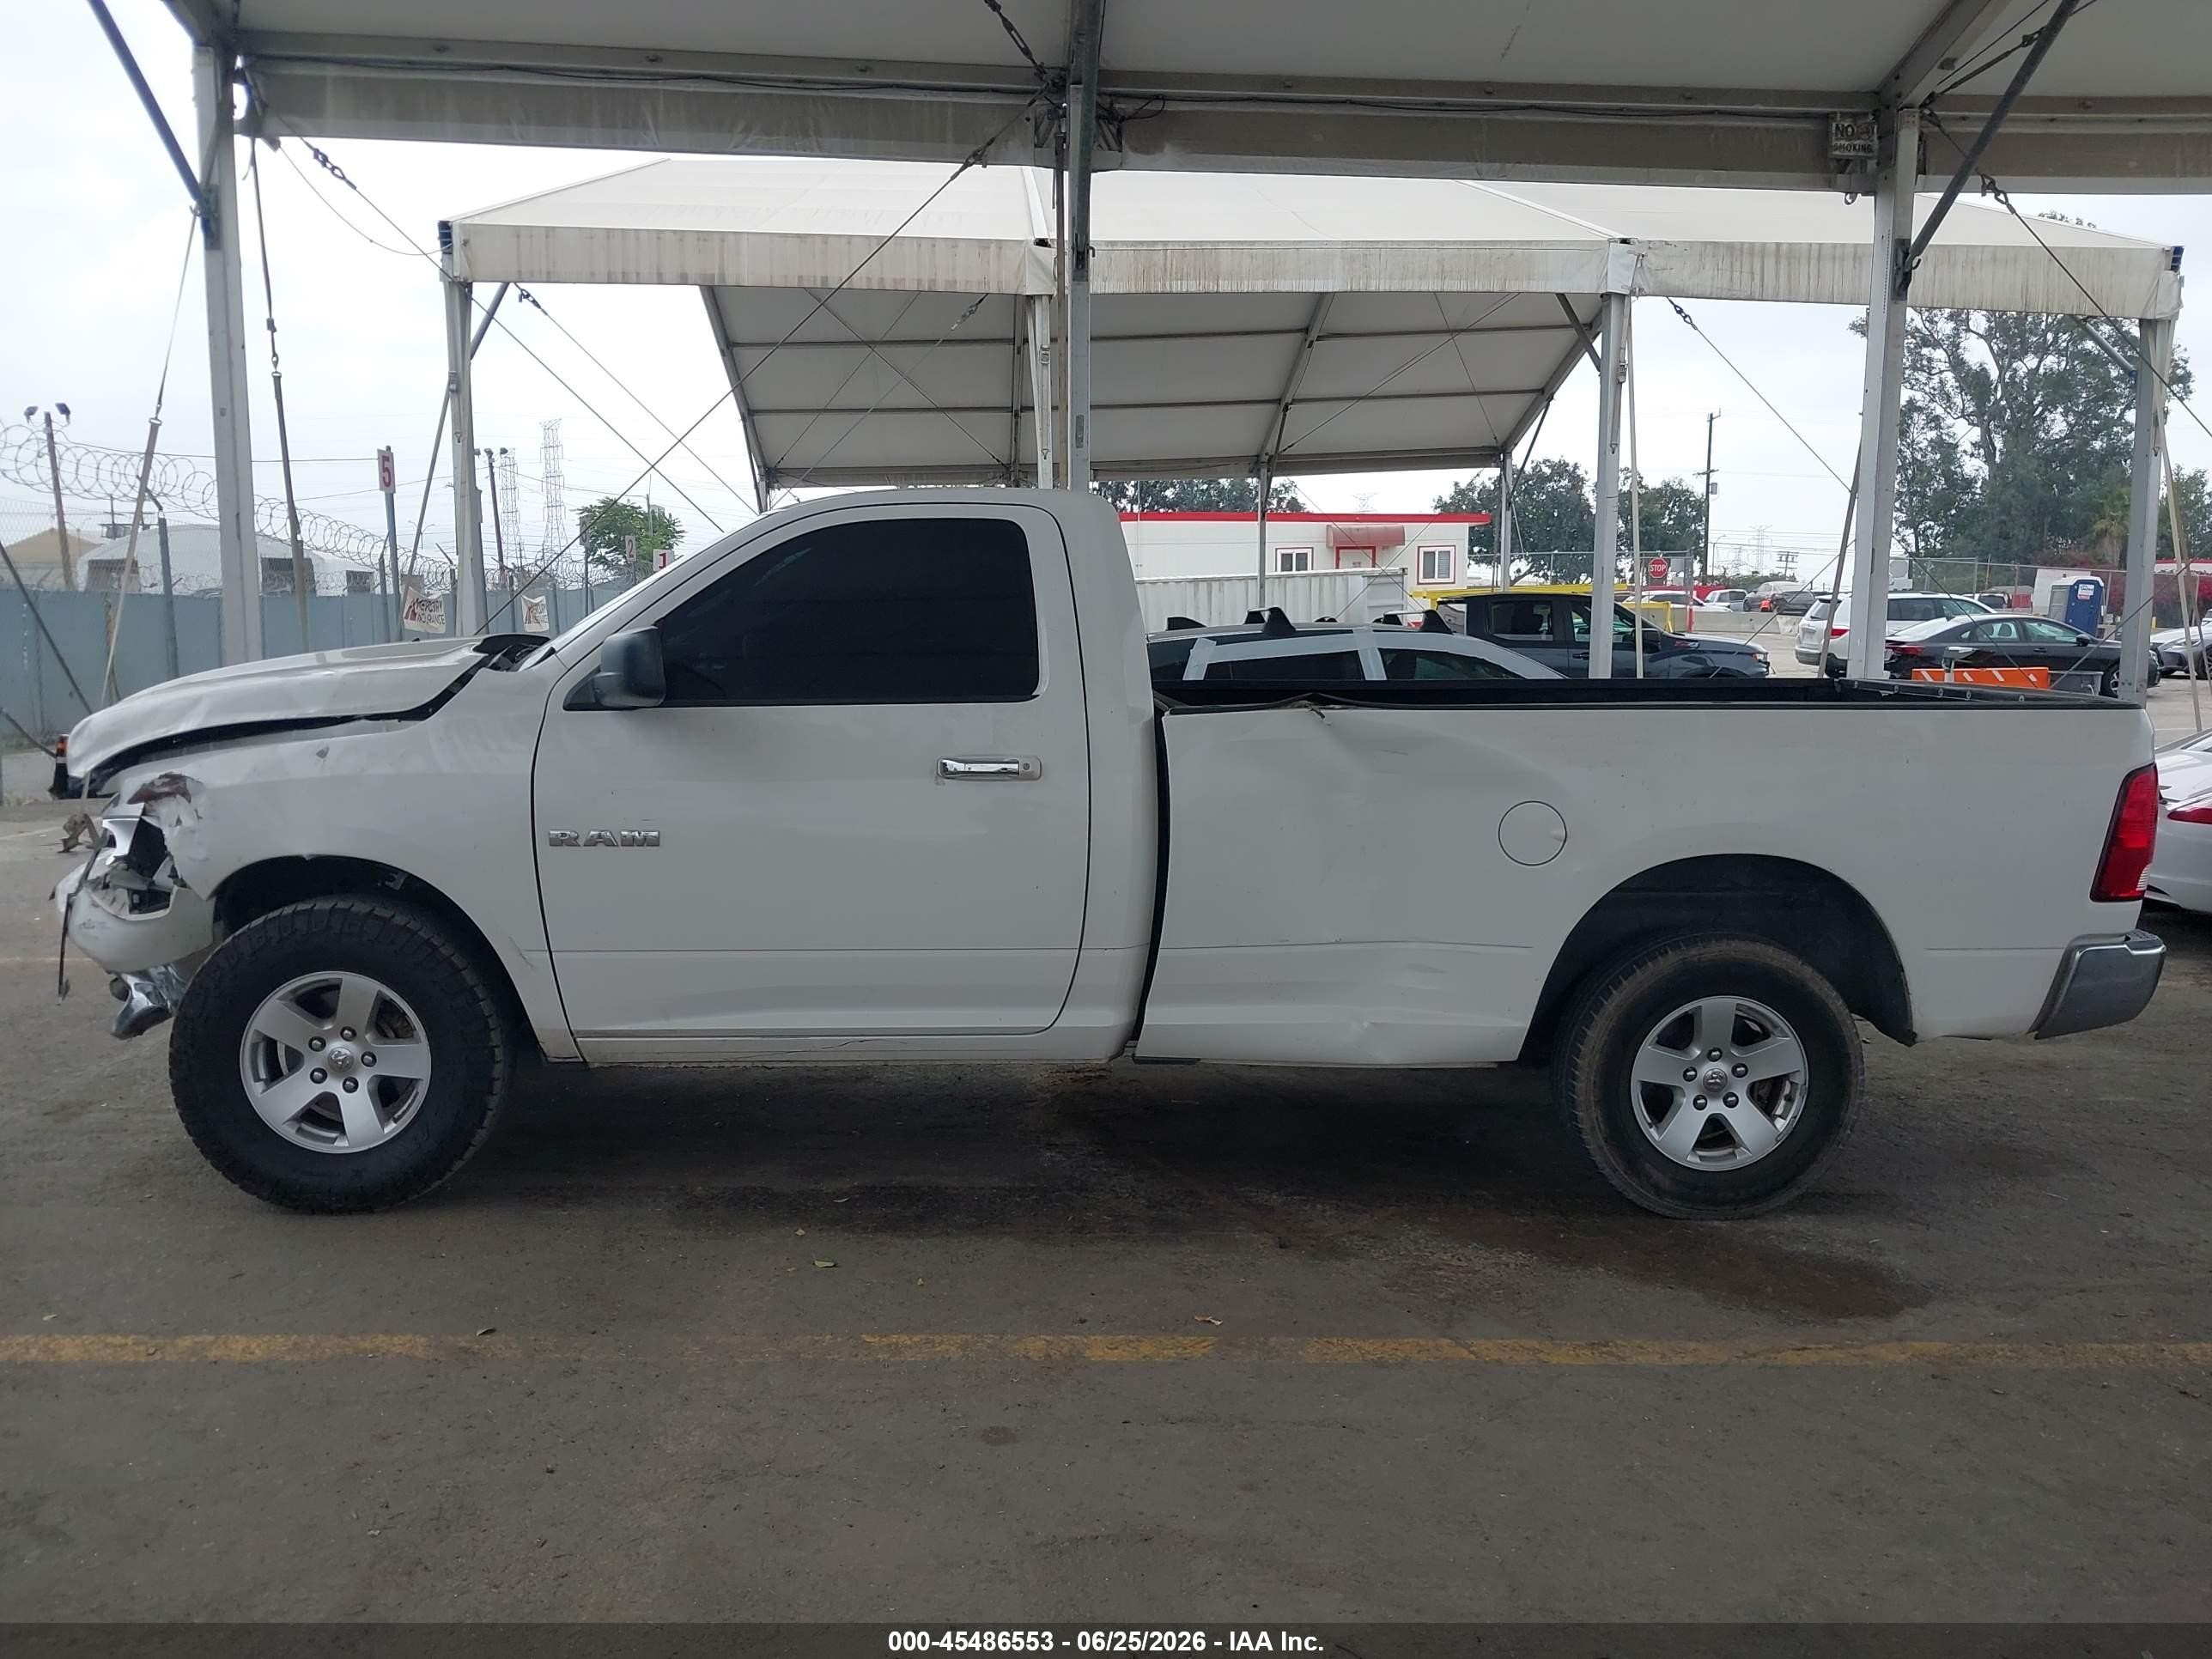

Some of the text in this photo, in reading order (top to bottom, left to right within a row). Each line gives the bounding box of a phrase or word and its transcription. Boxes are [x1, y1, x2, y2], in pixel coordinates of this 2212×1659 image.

[1835, 124, 1855, 137] NO
[1833, 143, 1872, 152] SMOKING
[381, 455, 392, 488] 5
[628, 539, 635, 558] 2
[549, 830, 660, 847] RAM
